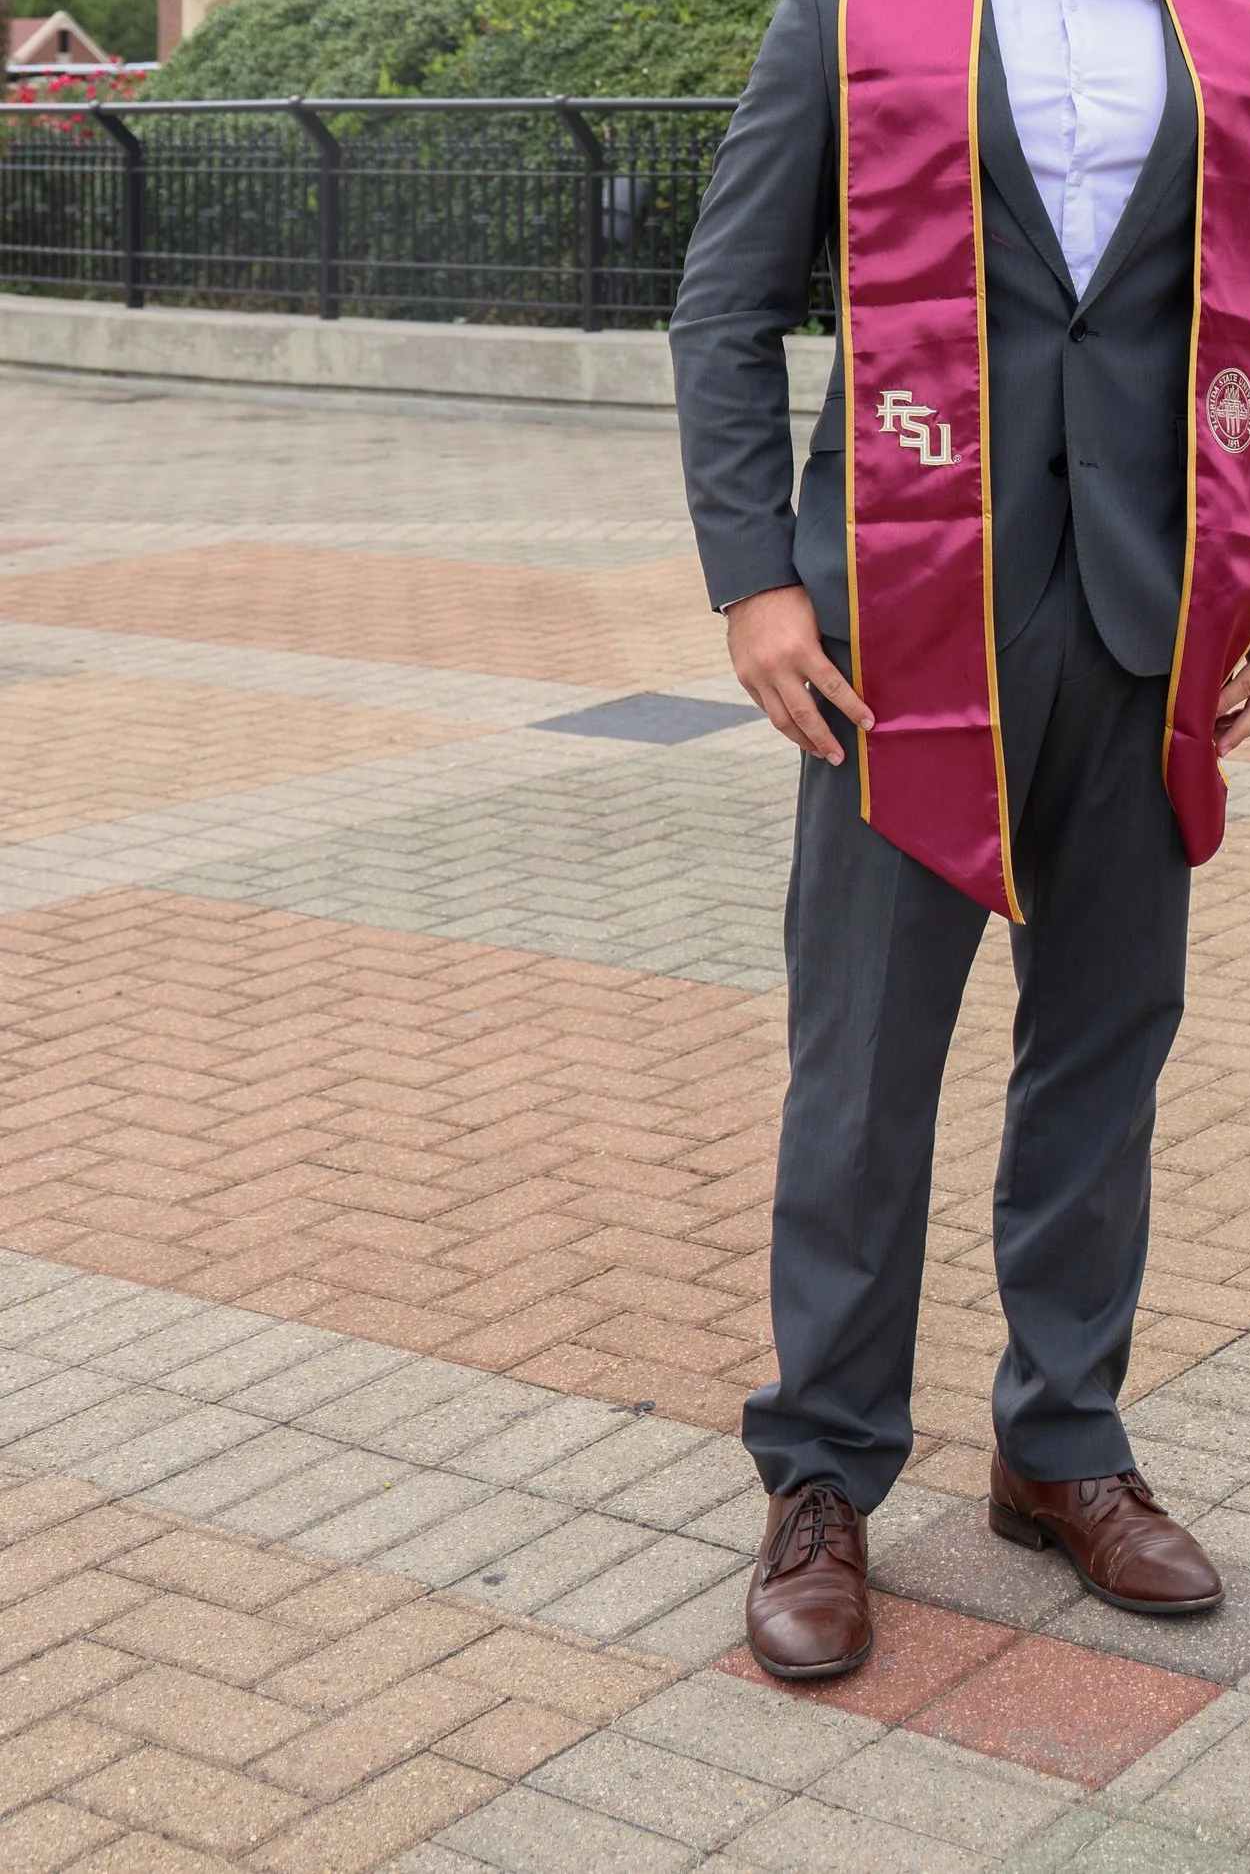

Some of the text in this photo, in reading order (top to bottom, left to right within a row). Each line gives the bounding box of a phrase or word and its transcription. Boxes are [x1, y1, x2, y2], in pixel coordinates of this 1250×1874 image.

[875, 390, 956, 465] FSU
[1209, 386, 1220, 431] FLORIDA
[1218, 373, 1238, 386] STATE
[1227, 438, 1240, 448] 1851
